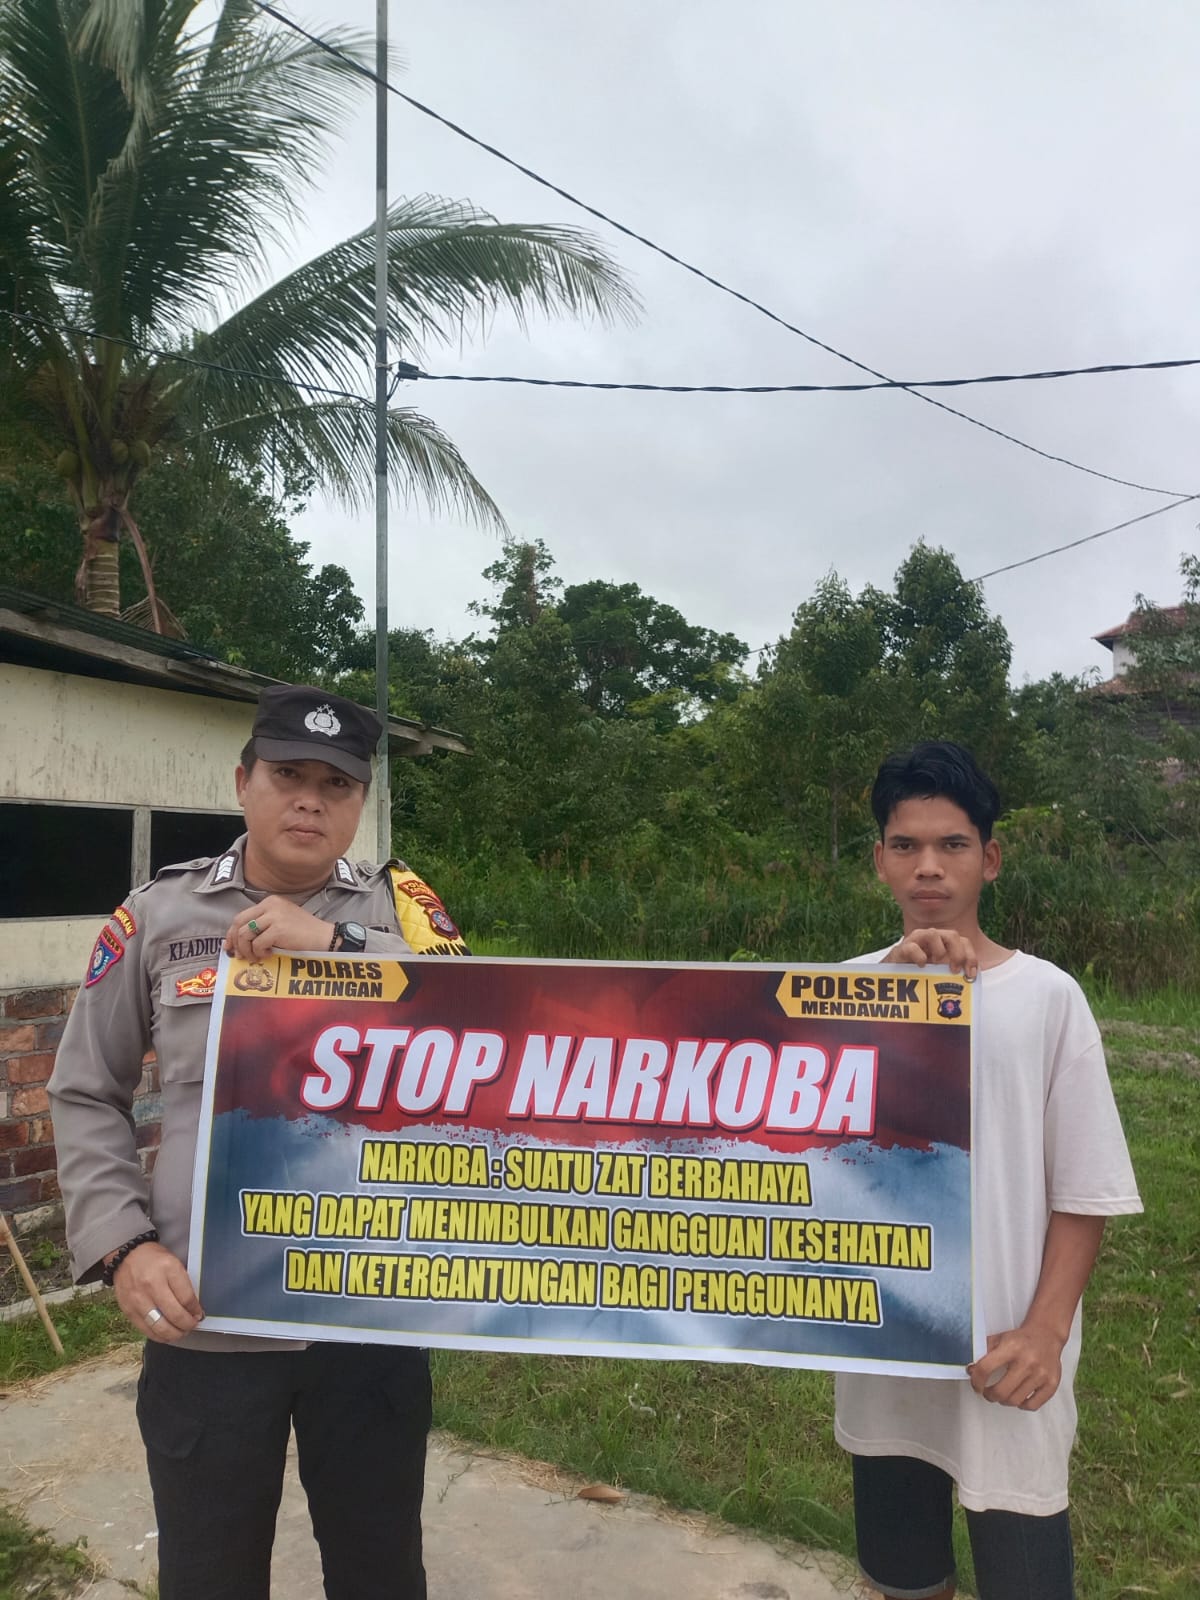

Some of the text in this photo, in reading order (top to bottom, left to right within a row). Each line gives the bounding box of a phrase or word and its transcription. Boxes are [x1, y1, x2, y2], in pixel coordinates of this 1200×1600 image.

[287, 979, 383, 998] KATINGAN
[290, 957, 383, 981] POLRES
[791, 975, 920, 1003] POLSEK
[801, 1001, 910, 1019] MENDAWAI
[302, 1025, 877, 1133] STOP NARKOBA
[361, 1141, 489, 1186] NARKOBA
[506, 1147, 593, 1193] SUATU
[596, 1153, 645, 1195] ZAT
[649, 1157, 811, 1205] BERBAHAYA
[242, 1192, 931, 1269] YANG DAPAT MENIMBULKAN GANGGUAN KESEHATAN
[286, 1249, 881, 1323] DAN KETERGANTUNGAN BAGI PENGGUNANYA
